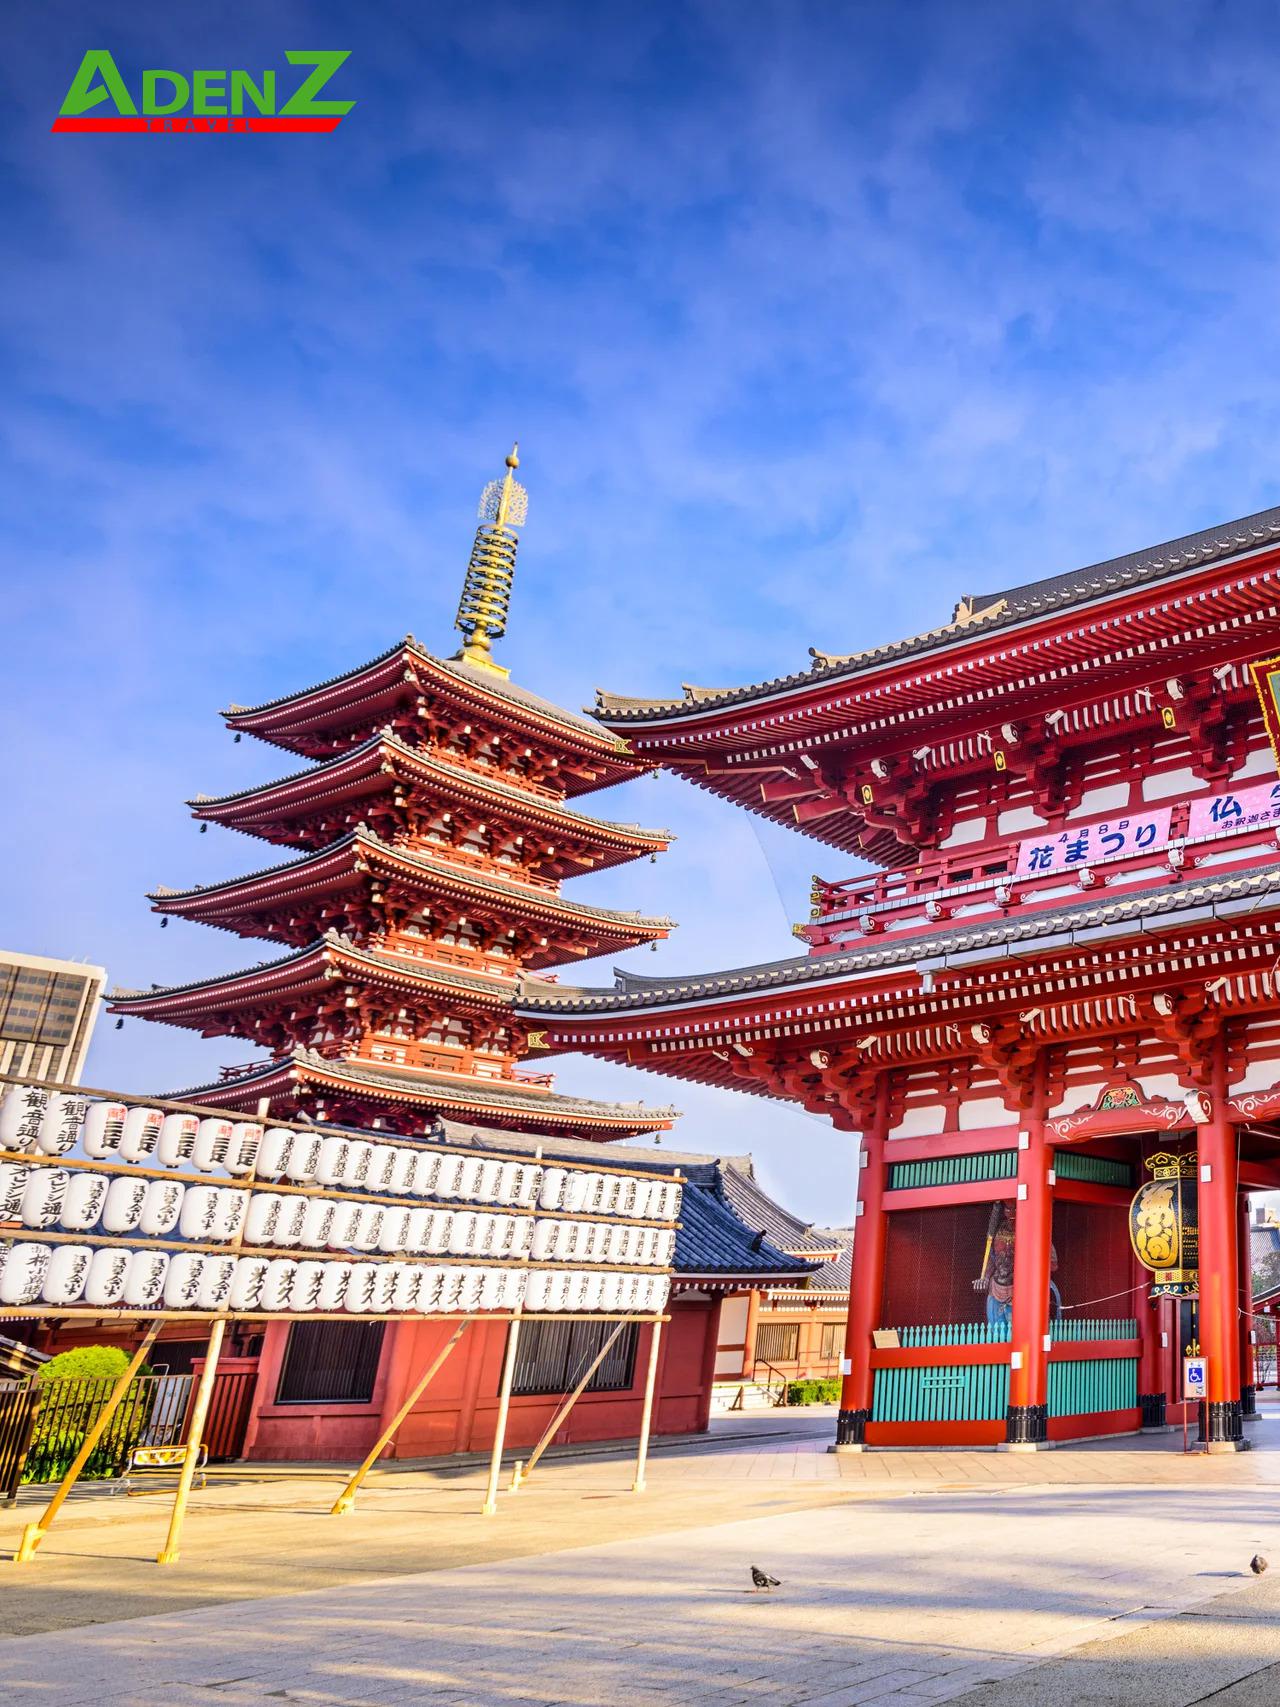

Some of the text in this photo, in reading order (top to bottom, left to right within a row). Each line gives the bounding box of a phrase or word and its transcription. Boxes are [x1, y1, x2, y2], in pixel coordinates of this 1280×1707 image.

[1028, 823, 1157, 871] 花まつり
[1058, 820, 1130, 843] 4月8日
[16, 1091, 48, 1147] 観音通り
[56, 1100, 85, 1152] 観音通り
[81, 1180, 104, 1221] 浅草今半
[125, 1185, 146, 1225] 浅草今半
[157, 1186, 179, 1226] 浅草今半
[201, 1192, 218, 1230] 浅草今半
[224, 1195, 243, 1233] 浅草今半
[64, 1254, 87, 1296] 浅草今半
[103, 1256, 127, 1298] 浅草今半
[142, 1257, 165, 1299] 浅草今半
[181, 1258, 204, 1300] 浅草今半
[211, 1261, 234, 1302] 浅草今半
[244, 1265, 268, 1302] 米久
[276, 1268, 297, 1303] 米久
[305, 1269, 325, 1305] 米久
[334, 1269, 352, 1304] 米久
[360, 1270, 377, 1304] 米久
[381, 1270, 400, 1305] 米久
[405, 1272, 424, 1304] 米久
[429, 1272, 446, 1305] 米久
[447, 1273, 466, 1305] 米久
[470, 1273, 486, 1304] 米久
